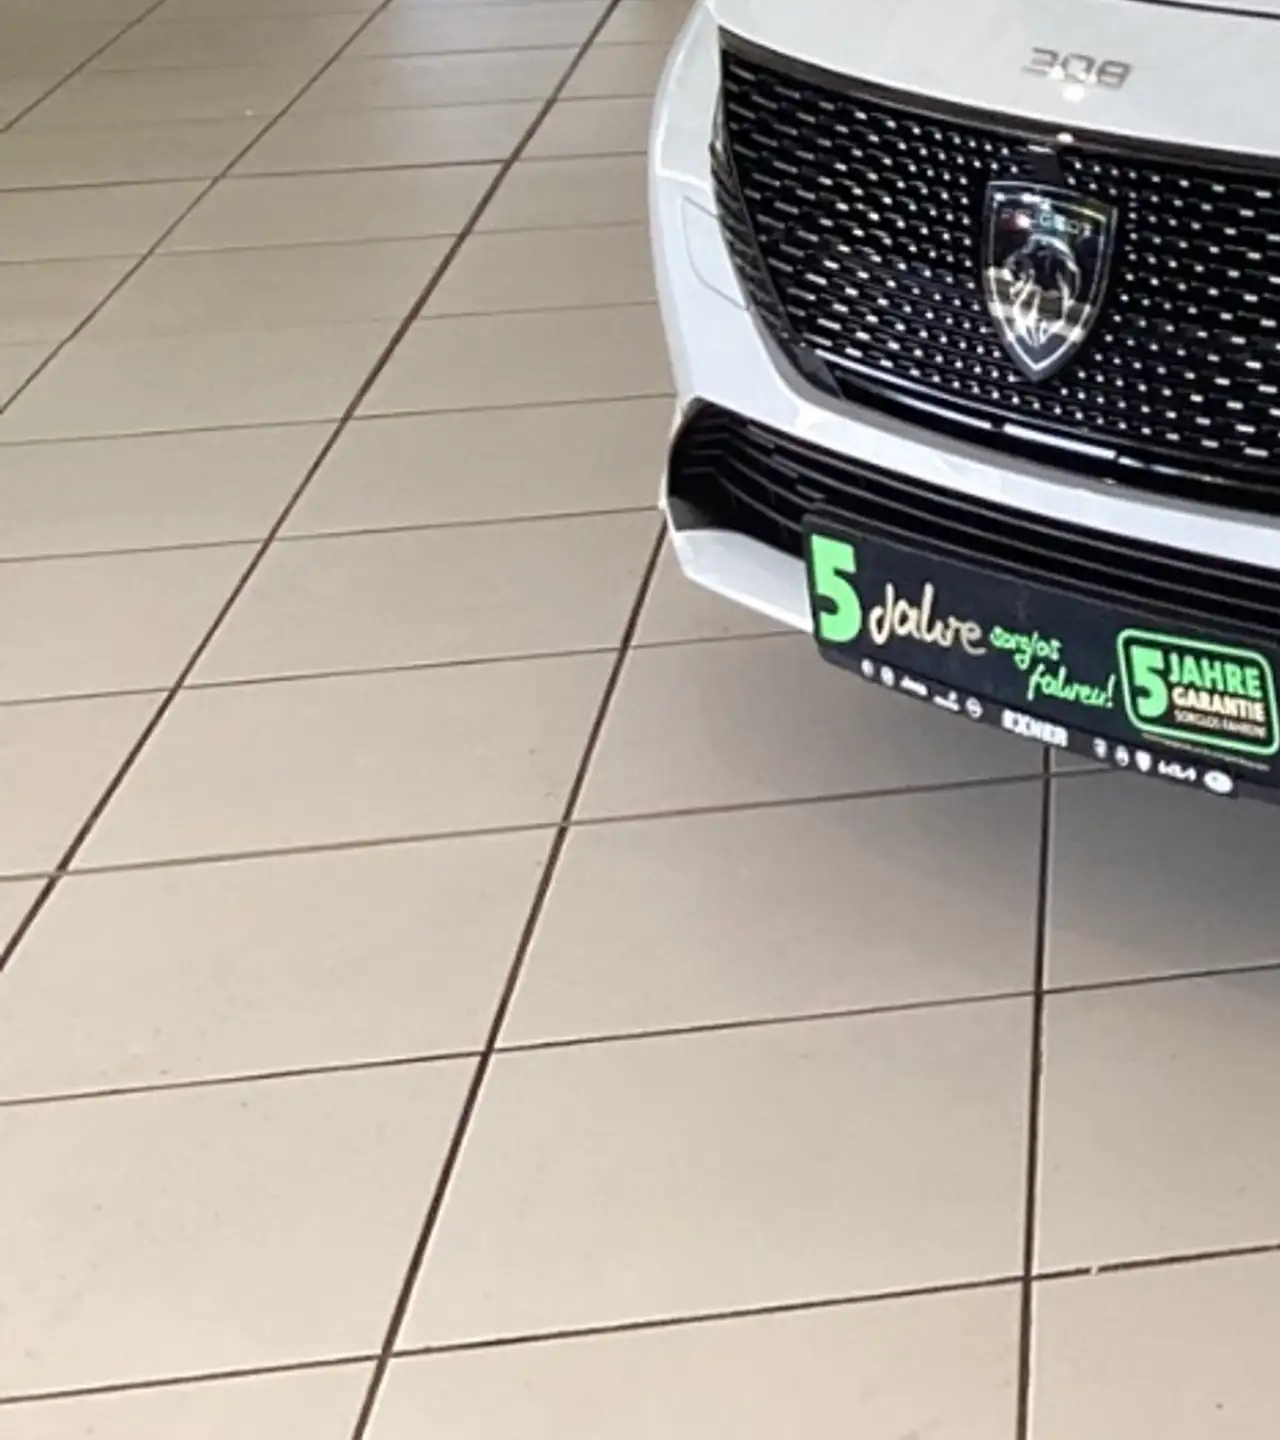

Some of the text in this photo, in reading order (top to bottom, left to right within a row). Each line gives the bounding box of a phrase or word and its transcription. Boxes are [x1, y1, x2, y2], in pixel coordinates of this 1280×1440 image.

[1020, 46, 1135, 91] 308
[811, 533, 1063, 670] 5 Jahre sorglos
[1130, 644, 1263, 718] 5 JAHRE
[1171, 685, 1266, 722] GARANTIE
